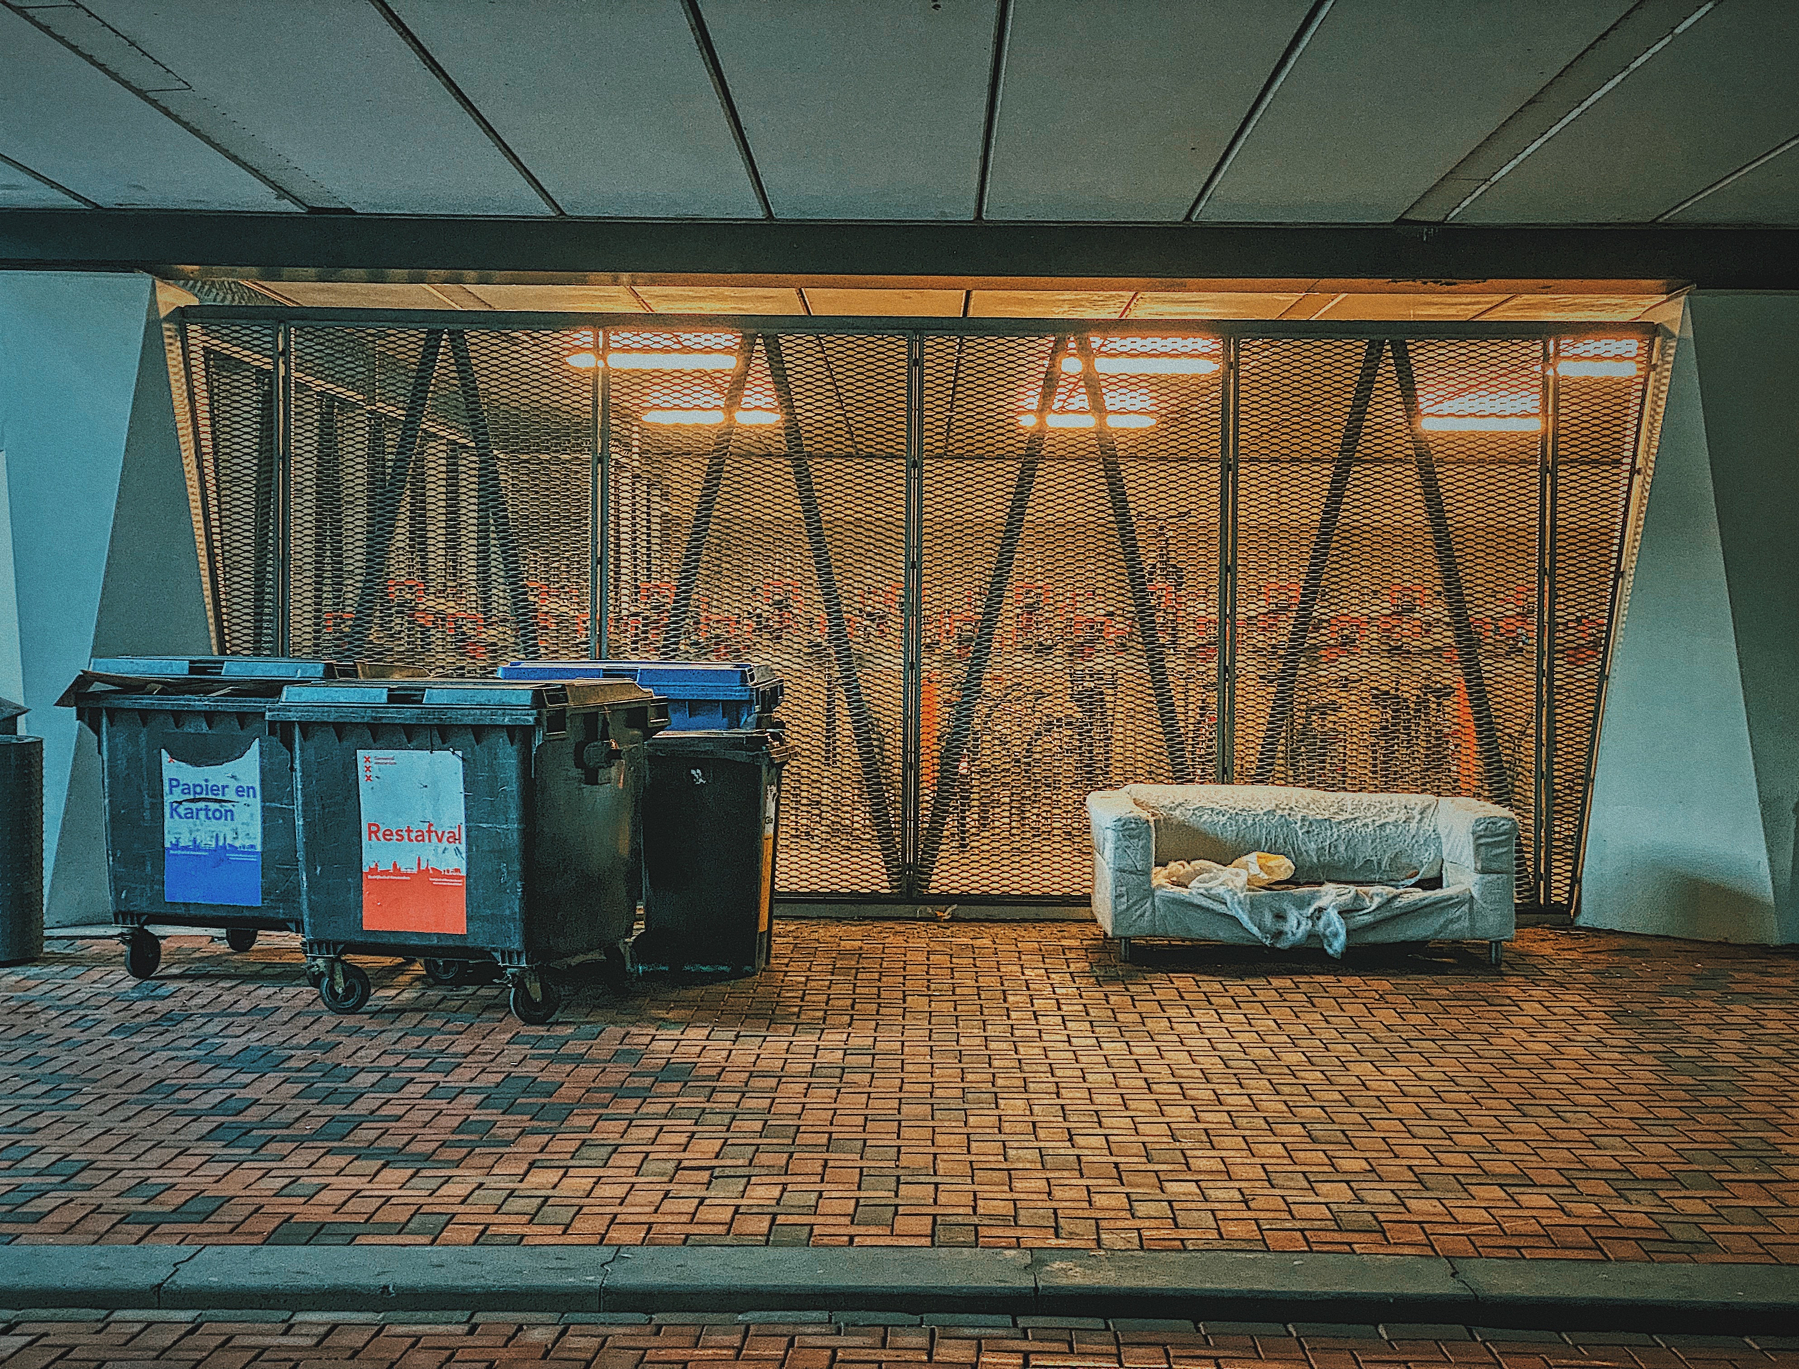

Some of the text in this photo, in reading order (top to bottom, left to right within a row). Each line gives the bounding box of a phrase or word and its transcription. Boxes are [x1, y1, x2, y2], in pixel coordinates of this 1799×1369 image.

[168, 777, 257, 798] Papier en
[168, 802, 235, 821] Karton
[367, 822, 462, 844] Restafval
